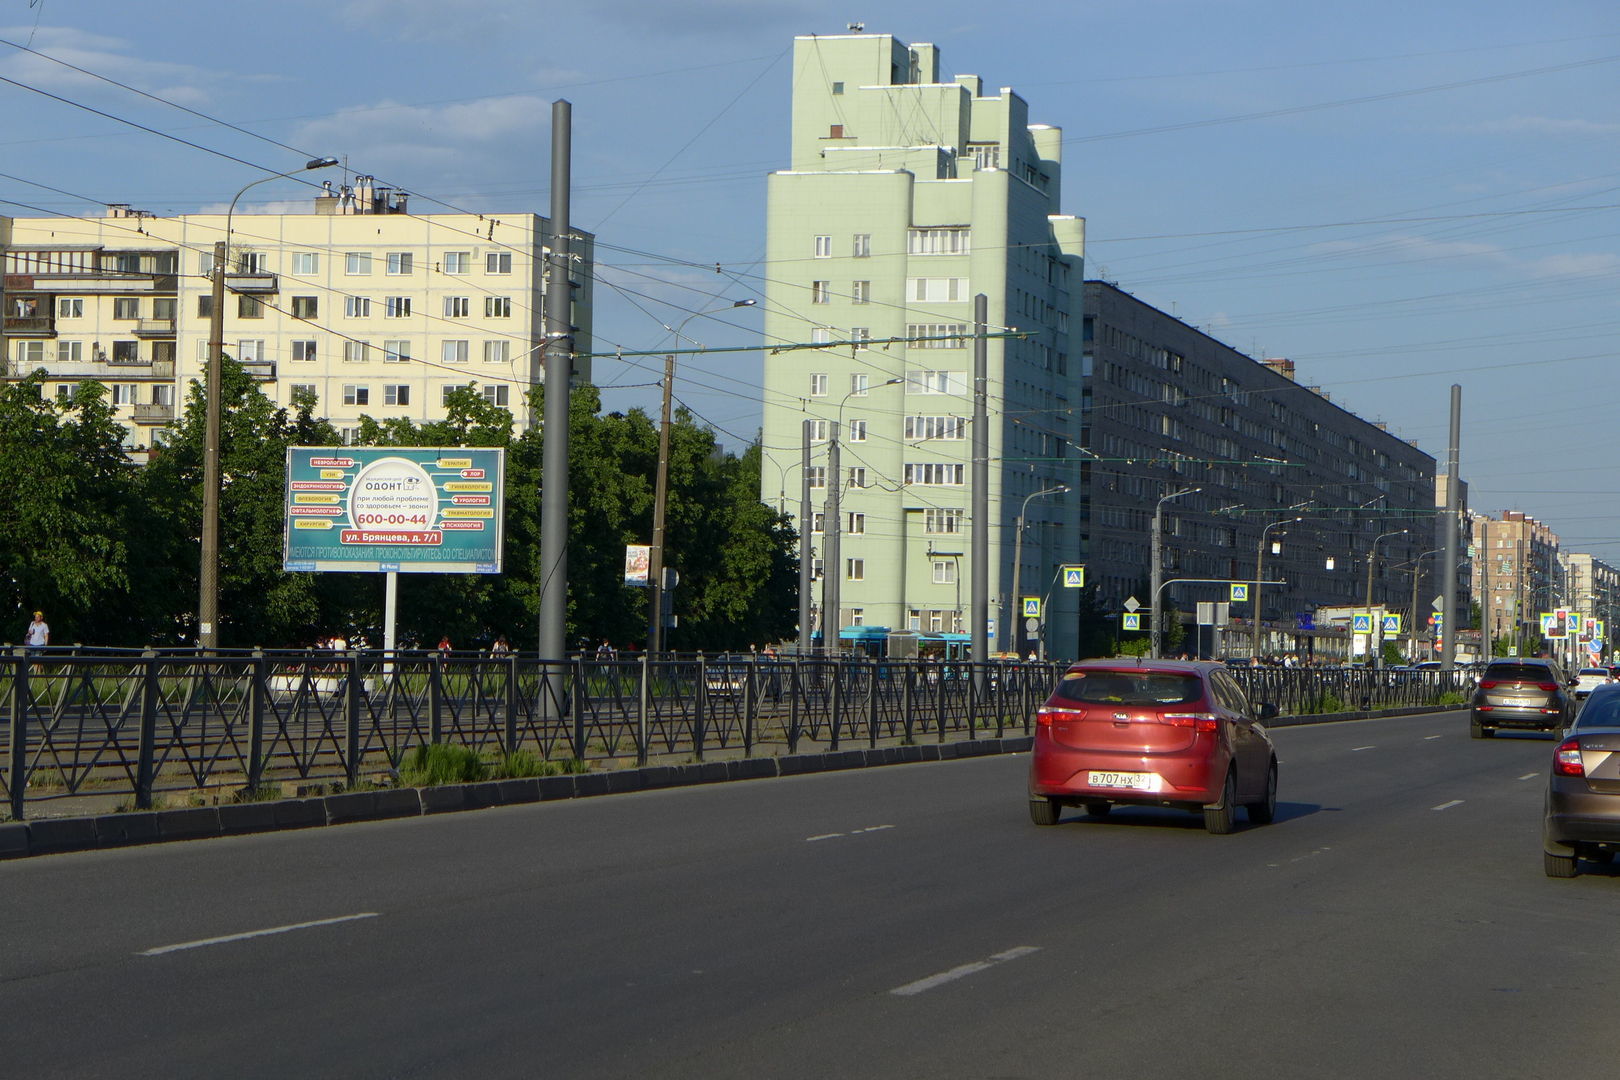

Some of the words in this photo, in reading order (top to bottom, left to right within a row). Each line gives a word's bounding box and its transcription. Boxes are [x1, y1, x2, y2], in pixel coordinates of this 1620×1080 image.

[366, 482, 402, 490] ОДОНТ
[358, 514, 427, 524] 600-00-44
[346, 534, 360, 542] ул.
[362, 533, 411, 542] Брянцева,
[424, 534, 438, 542] 7/1
[442, 548, 451, 560] СО
